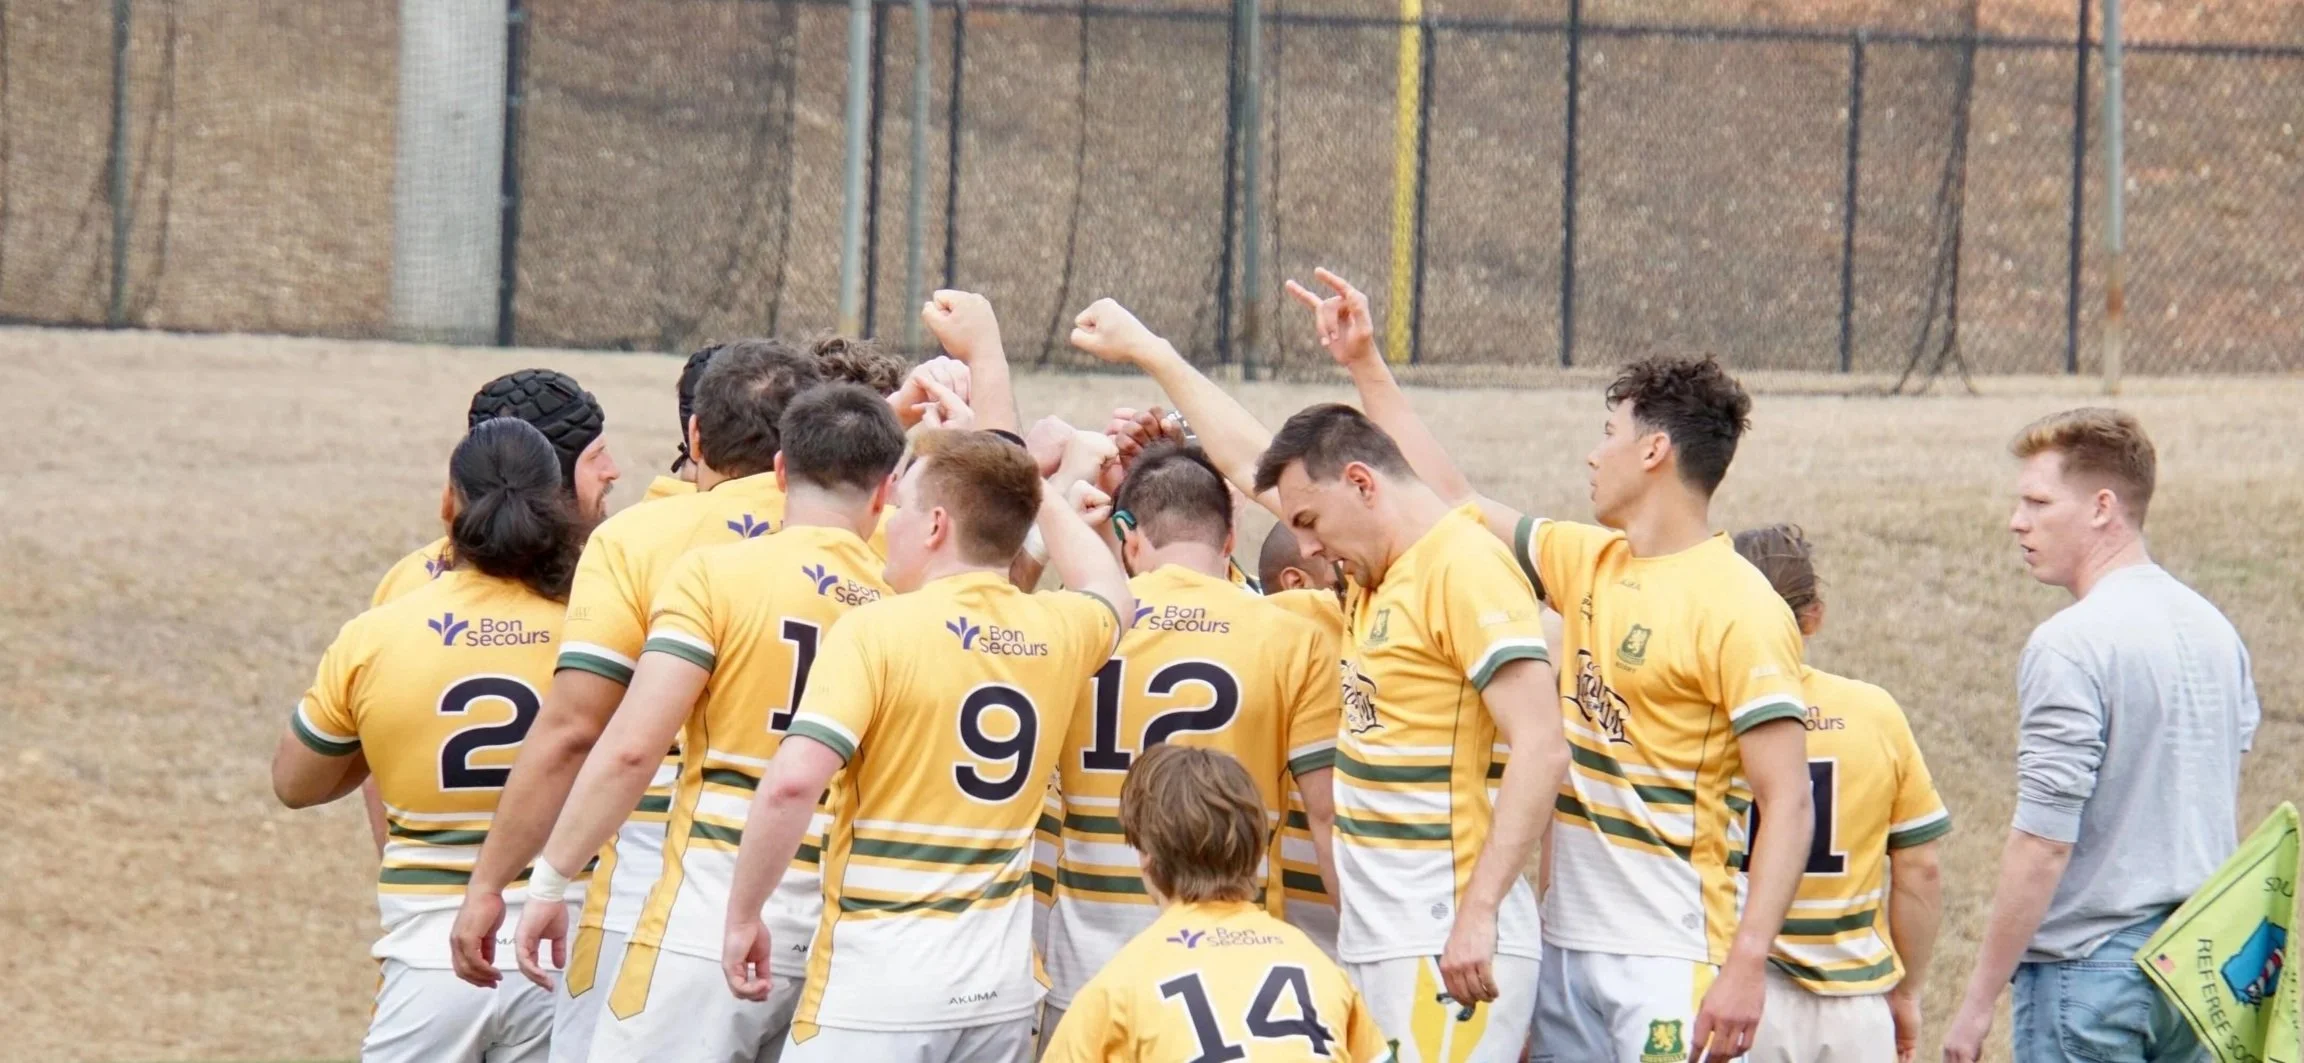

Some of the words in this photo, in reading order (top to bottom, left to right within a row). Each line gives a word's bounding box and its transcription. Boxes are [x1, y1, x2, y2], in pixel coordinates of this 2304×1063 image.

[847, 579, 881, 600] Bon
[1164, 605, 1206, 619] Bon
[480, 618, 522, 633] Bon
[989, 625, 1025, 642] Bon
[1148, 616, 1230, 634] Secours
[466, 630, 550, 647] Secours
[979, 637, 1049, 656] Secours
[1081, 656, 1243, 774] 12
[437, 673, 544, 791] 2
[1804, 717, 1845, 731] ours
[952, 682, 1040, 805] 9
[1207, 935, 1284, 947] Secours
[1216, 927, 1256, 938] Bon
[2197, 938, 2233, 1036] REFEREE
[949, 990, 998, 1005] AKUMA
[1157, 964, 1336, 1063] 14
